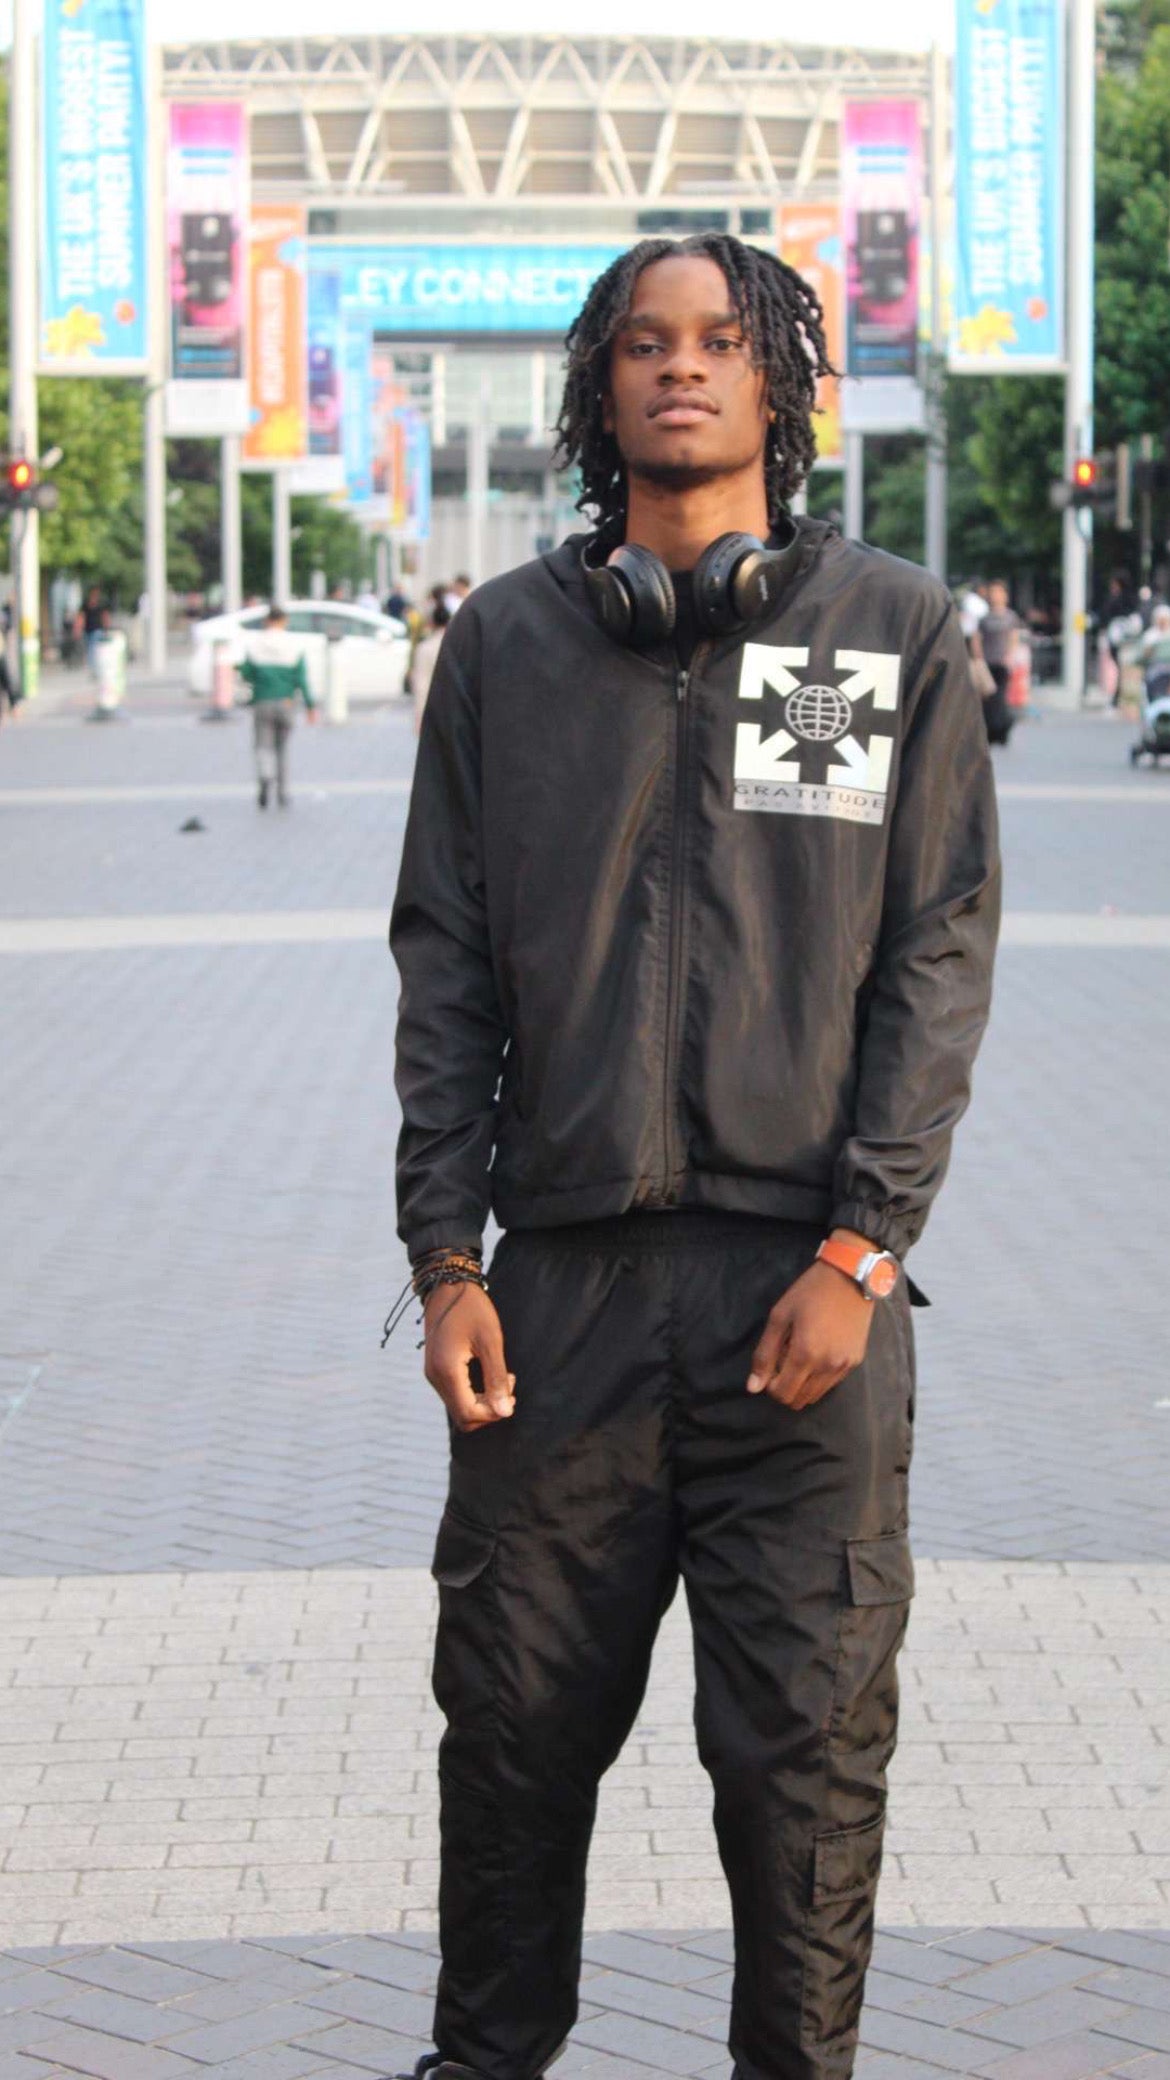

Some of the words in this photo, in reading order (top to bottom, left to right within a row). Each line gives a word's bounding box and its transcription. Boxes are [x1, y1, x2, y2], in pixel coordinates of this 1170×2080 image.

[58, 240, 94, 298] THE
[971, 240, 1006, 296] THE
[735, 784, 885, 809] GRATITUDE
